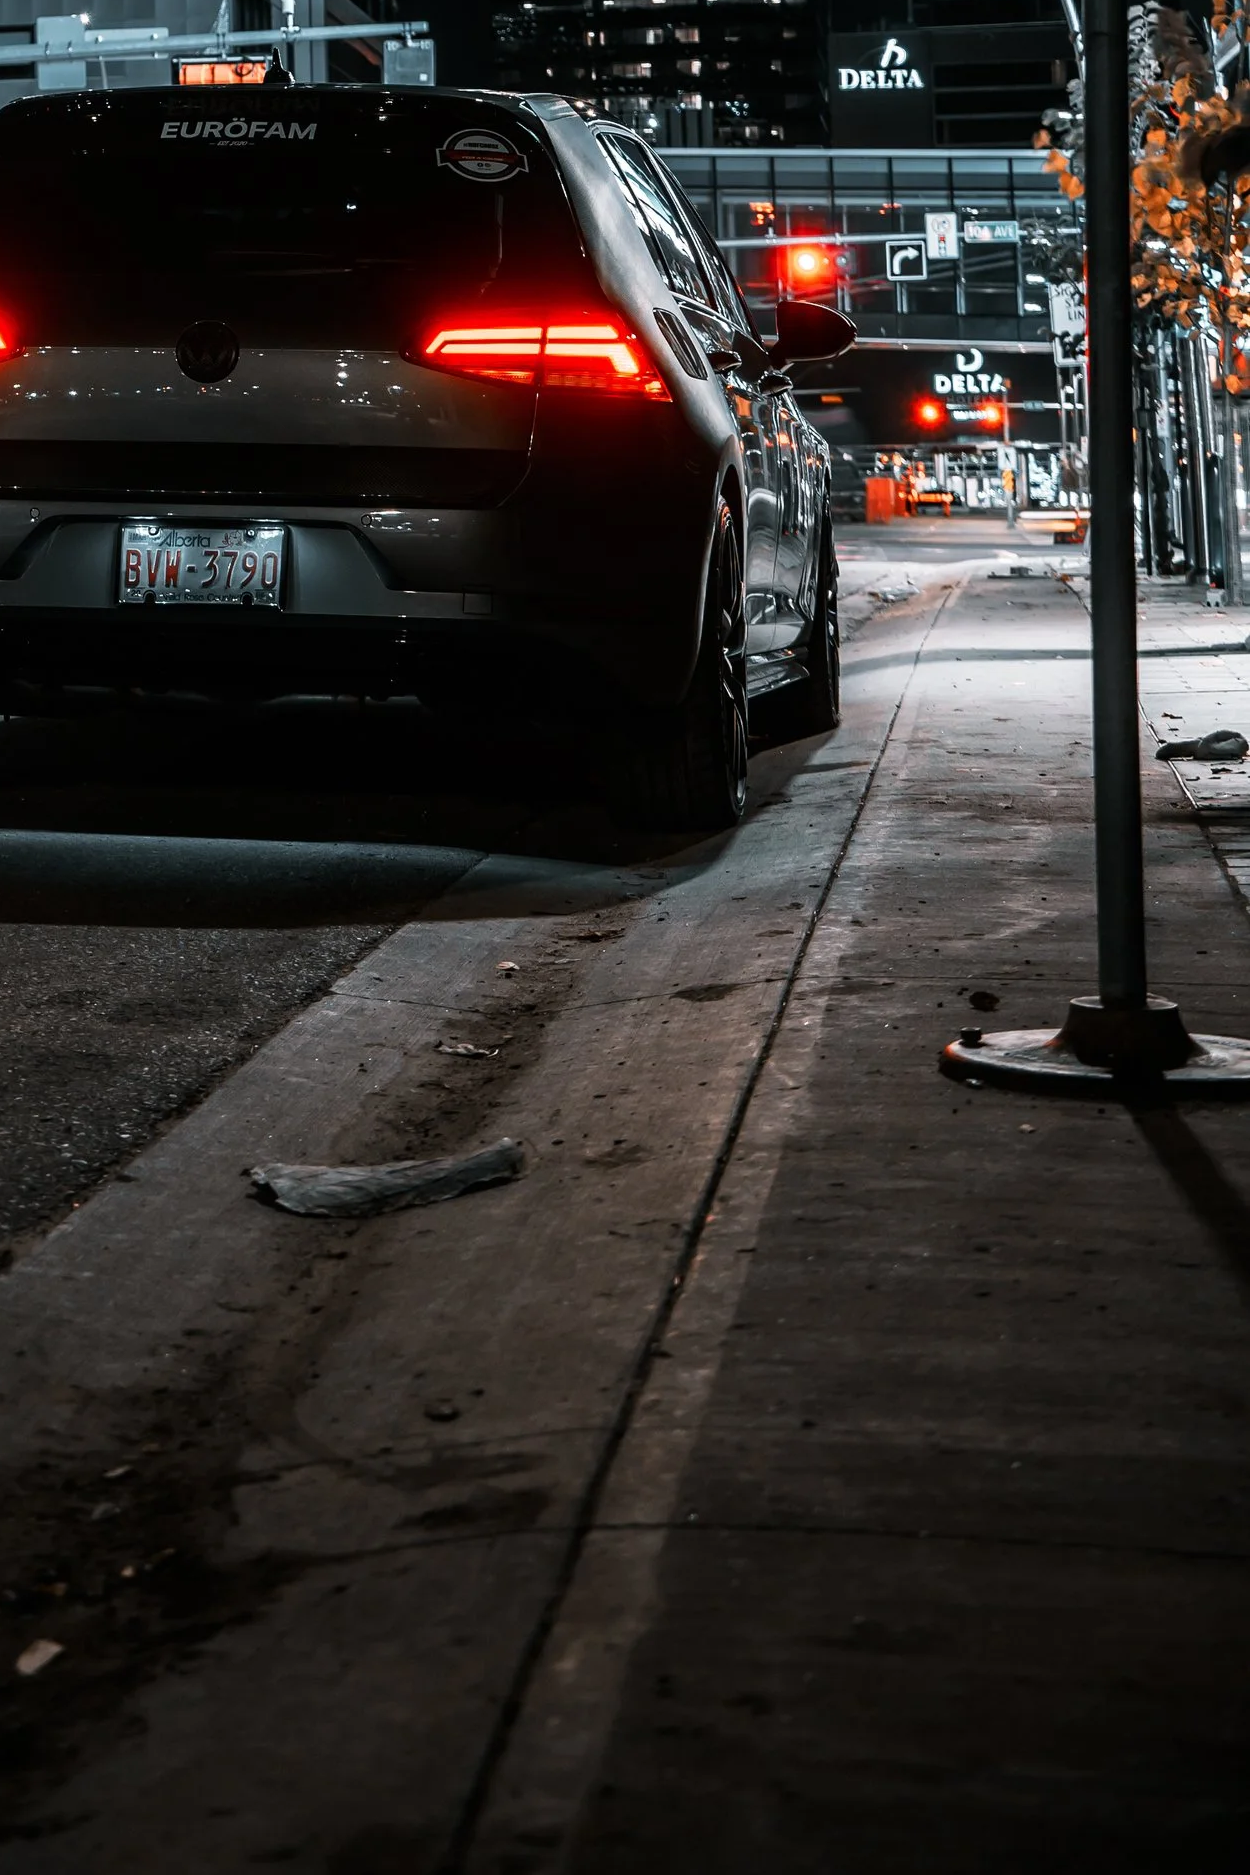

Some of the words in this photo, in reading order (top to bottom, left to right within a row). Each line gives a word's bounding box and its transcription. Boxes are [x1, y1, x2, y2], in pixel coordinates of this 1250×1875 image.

[838, 68, 925, 90] DELTA
[160, 117, 318, 140] EURÖFAM
[994, 225, 1013, 237] AVE
[934, 373, 1007, 394] DELTA
[158, 530, 211, 547] Alberta
[125, 549, 279, 590] BVW-3790
[183, 593, 204, 601] Rose
